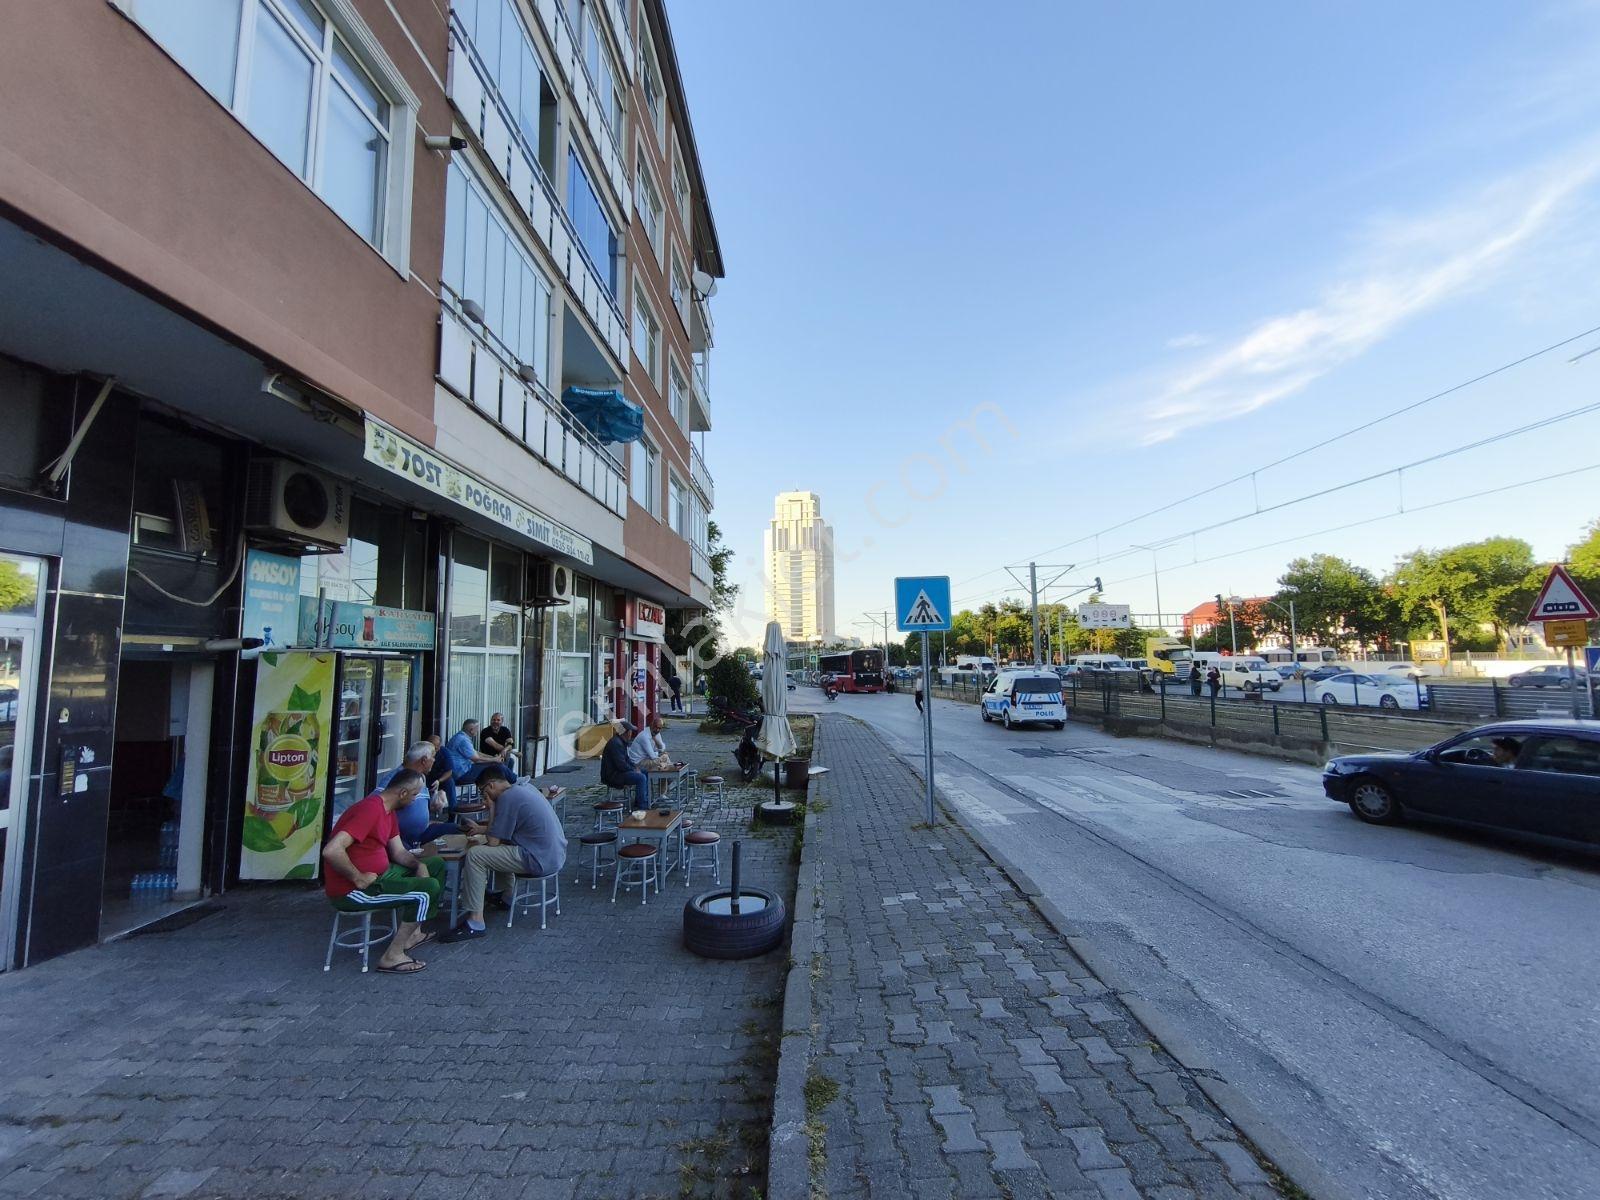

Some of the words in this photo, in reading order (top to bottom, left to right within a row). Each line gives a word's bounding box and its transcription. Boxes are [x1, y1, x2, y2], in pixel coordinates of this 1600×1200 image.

[401, 446, 442, 487] TOST
[465, 484, 512, 523] POĞAÇA
[526, 514, 550, 543] SİMİT
[250, 559, 298, 587] AKSOY
[272, 752, 305, 764] Lipton
